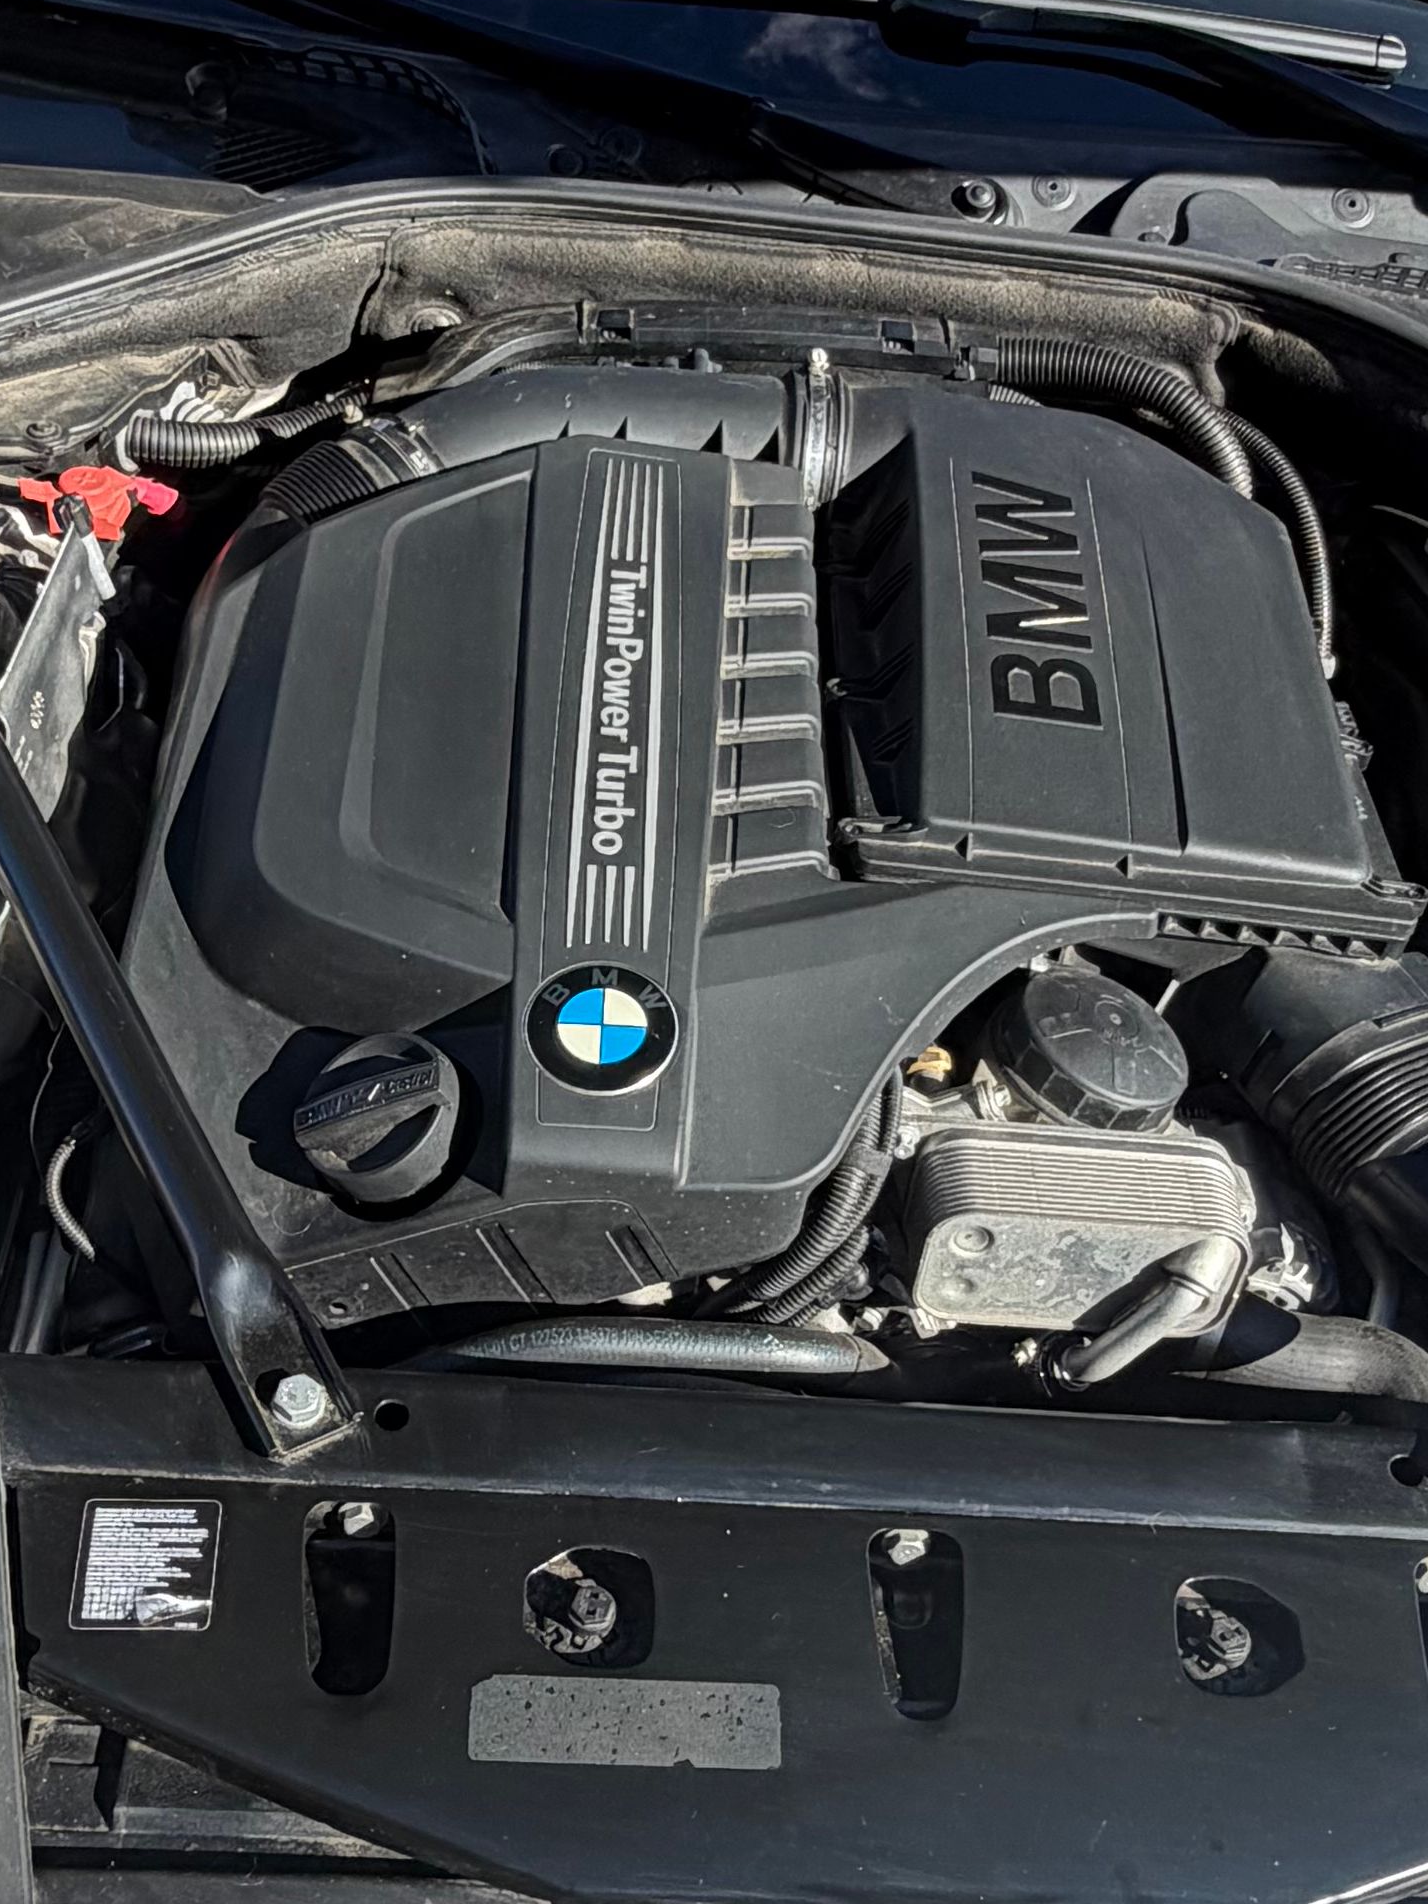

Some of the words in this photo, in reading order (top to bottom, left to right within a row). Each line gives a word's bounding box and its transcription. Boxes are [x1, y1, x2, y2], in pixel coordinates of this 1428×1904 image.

[600, 565, 647, 743] TwinPower
[971, 471, 1104, 730] BMW
[591, 746, 638, 856] Turbo
[540, 968, 668, 1010] BMW
